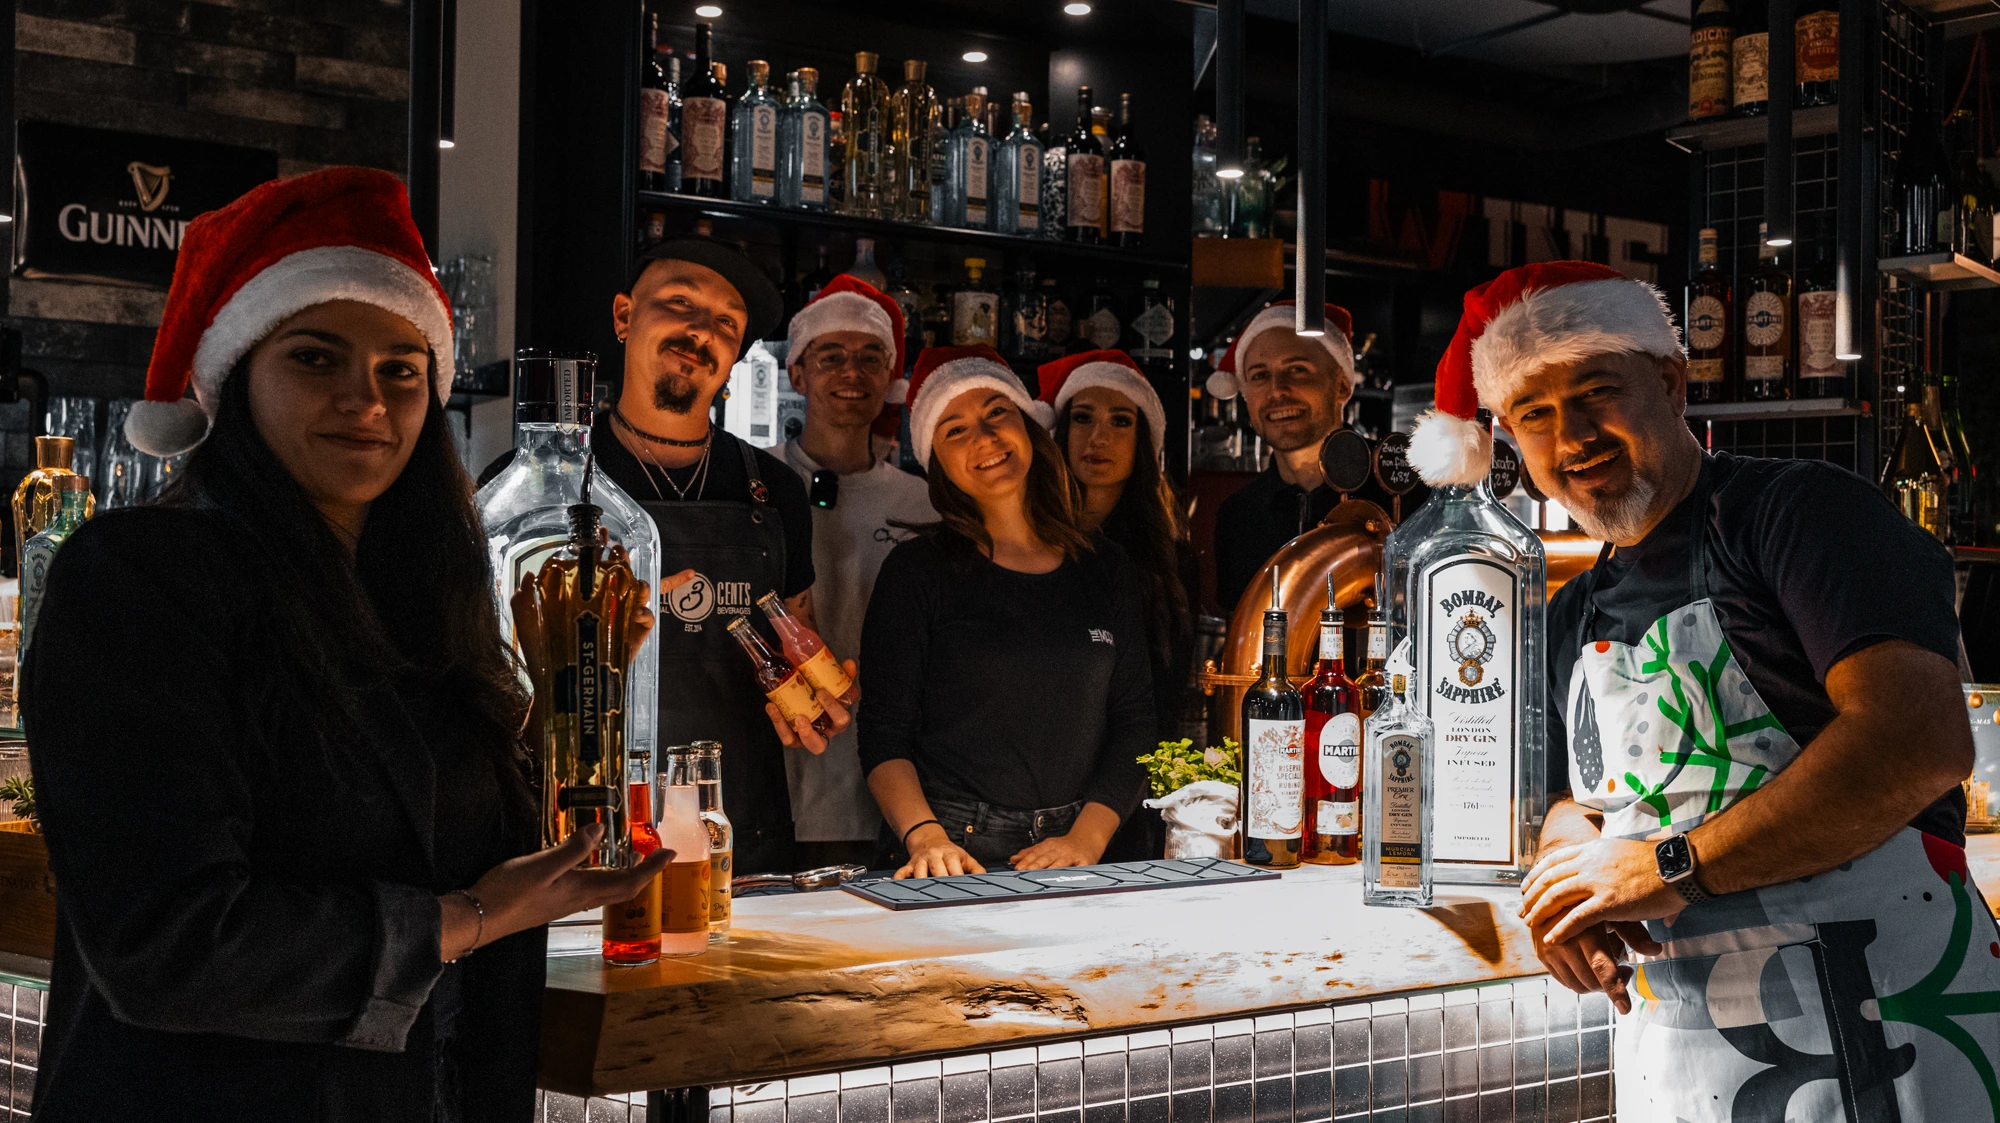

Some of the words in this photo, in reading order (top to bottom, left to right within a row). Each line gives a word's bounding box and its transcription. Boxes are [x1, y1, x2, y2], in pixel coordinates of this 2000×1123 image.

[563, 369, 572, 422] IMPORTED
[717, 582, 751, 606] CENTS
[1439, 589, 1505, 618] BOMBAY
[716, 606, 752, 615] BEVERAGES
[582, 641, 596, 736] ST-GERMAIN
[1435, 676, 1506, 705] SAPPHIRE
[1445, 734, 1470, 742] DRY
[1473, 734, 1498, 743] GIN
[1389, 740, 1414, 751] BOMBAY
[1447, 759, 1496, 767] INFUSED
[1388, 772, 1416, 784] SAPPHIRE
[1393, 791, 1412, 801] Cru
[1463, 801, 1479, 809] 1761
